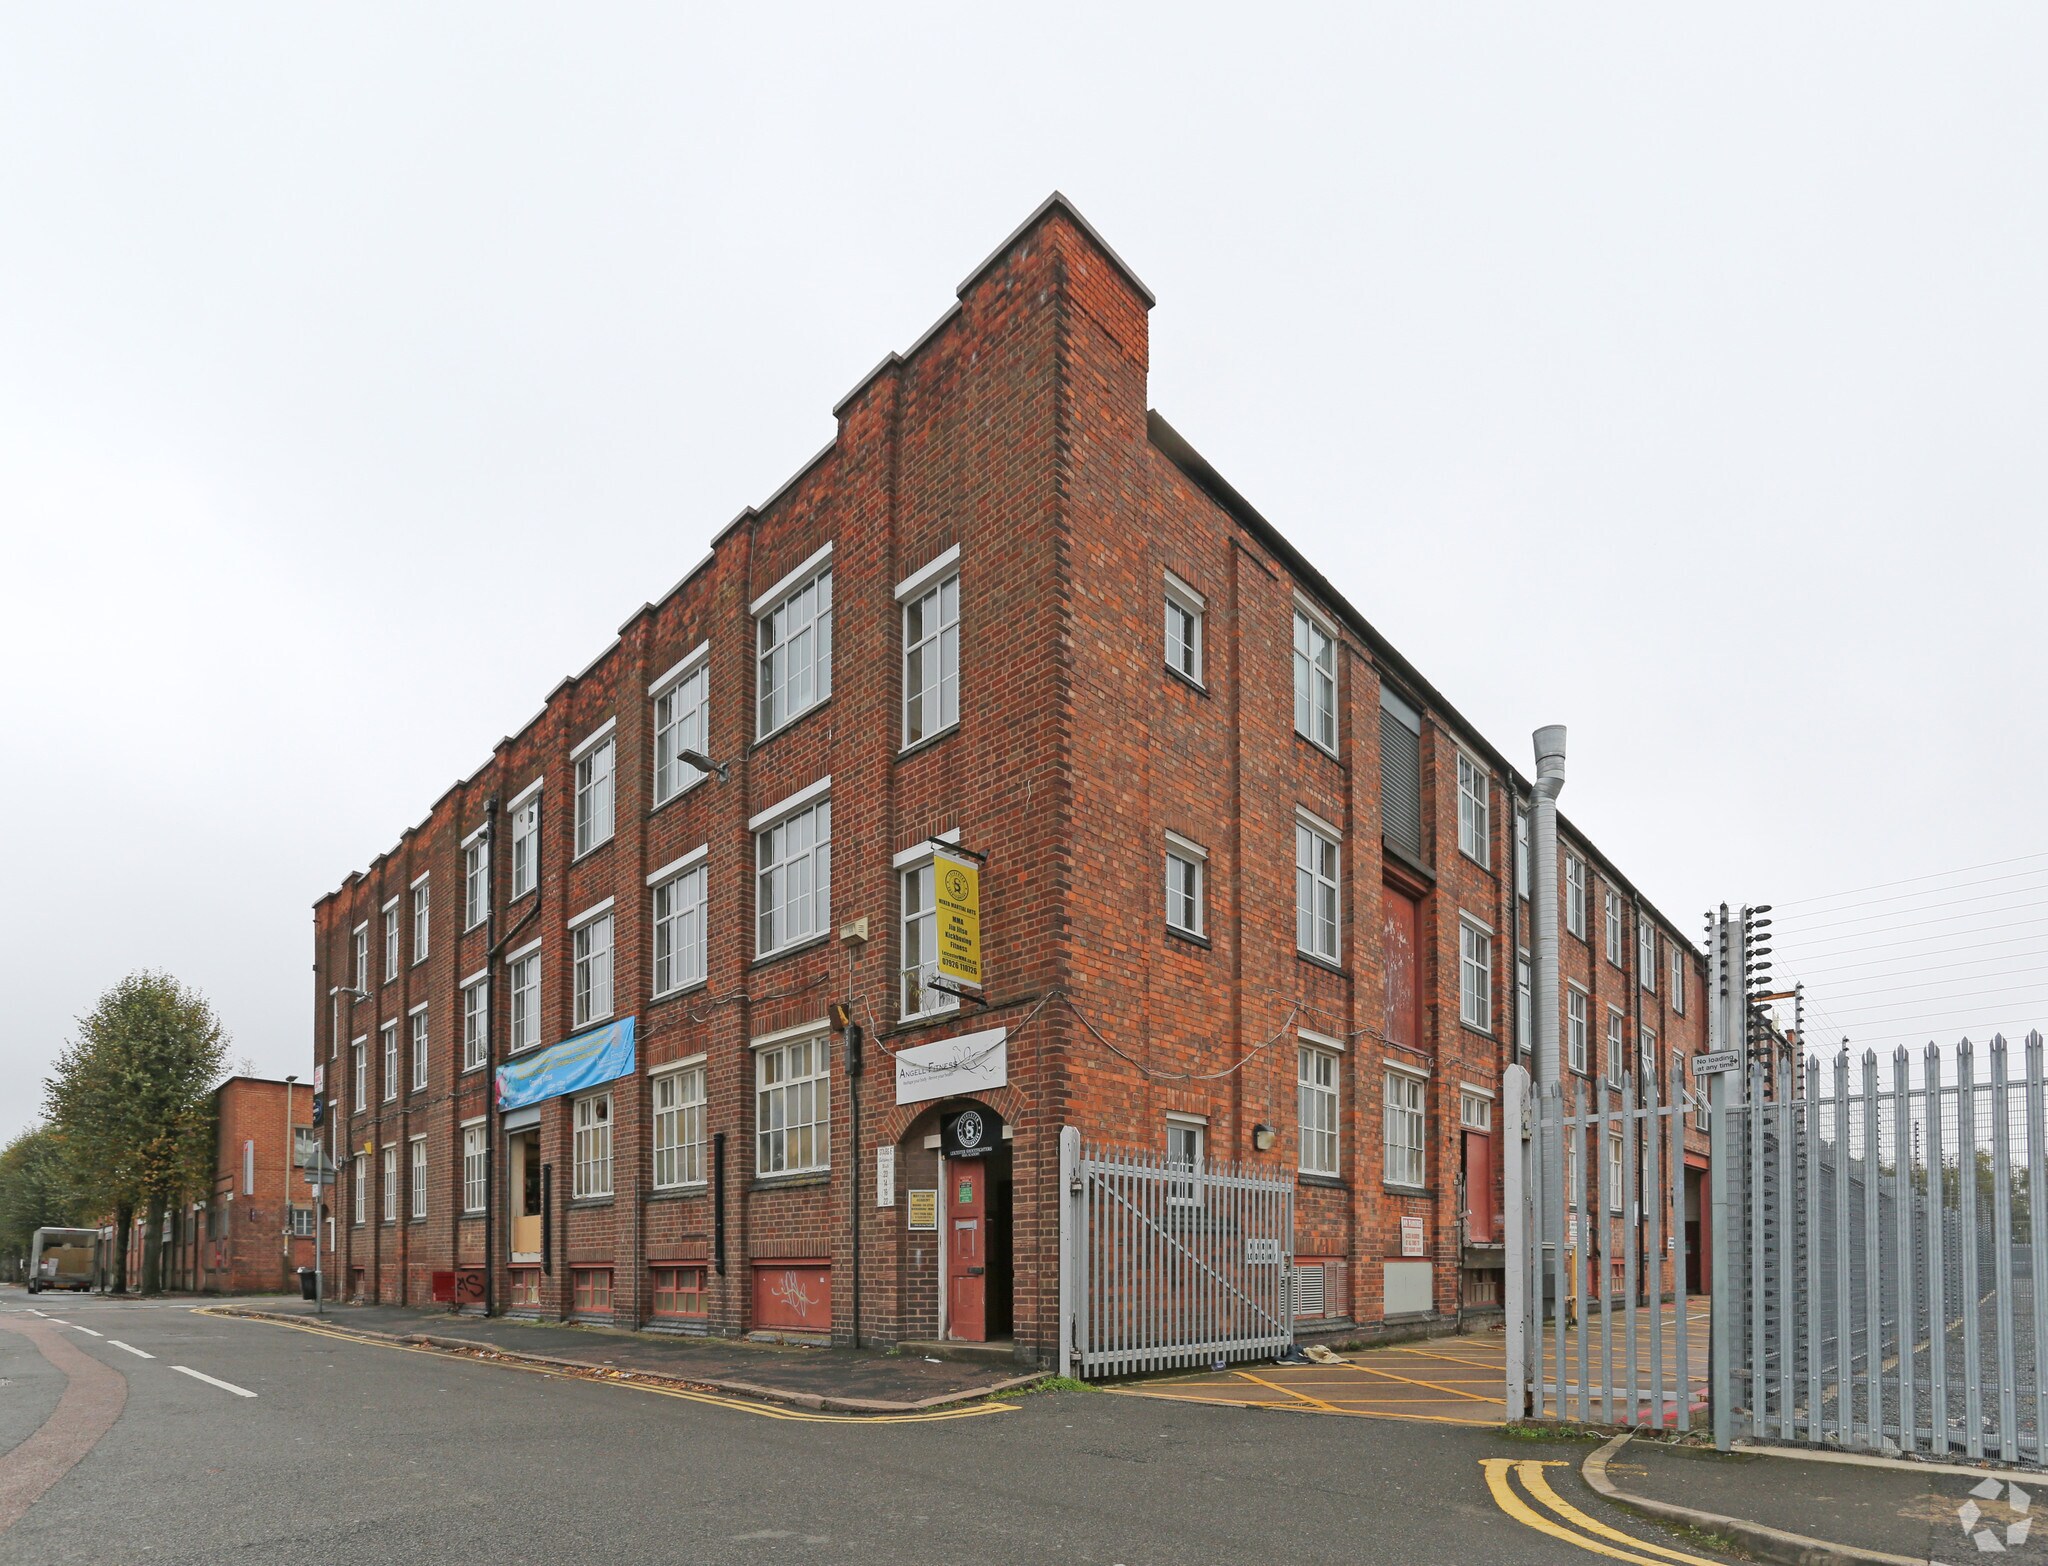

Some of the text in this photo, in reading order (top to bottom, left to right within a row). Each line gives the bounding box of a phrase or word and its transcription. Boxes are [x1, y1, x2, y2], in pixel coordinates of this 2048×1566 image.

[952, 916, 964, 925] MMA
[945, 931, 972, 946] Kickboxing
[950, 942, 968, 952] Fitness
[942, 958, 959, 969] 07926
